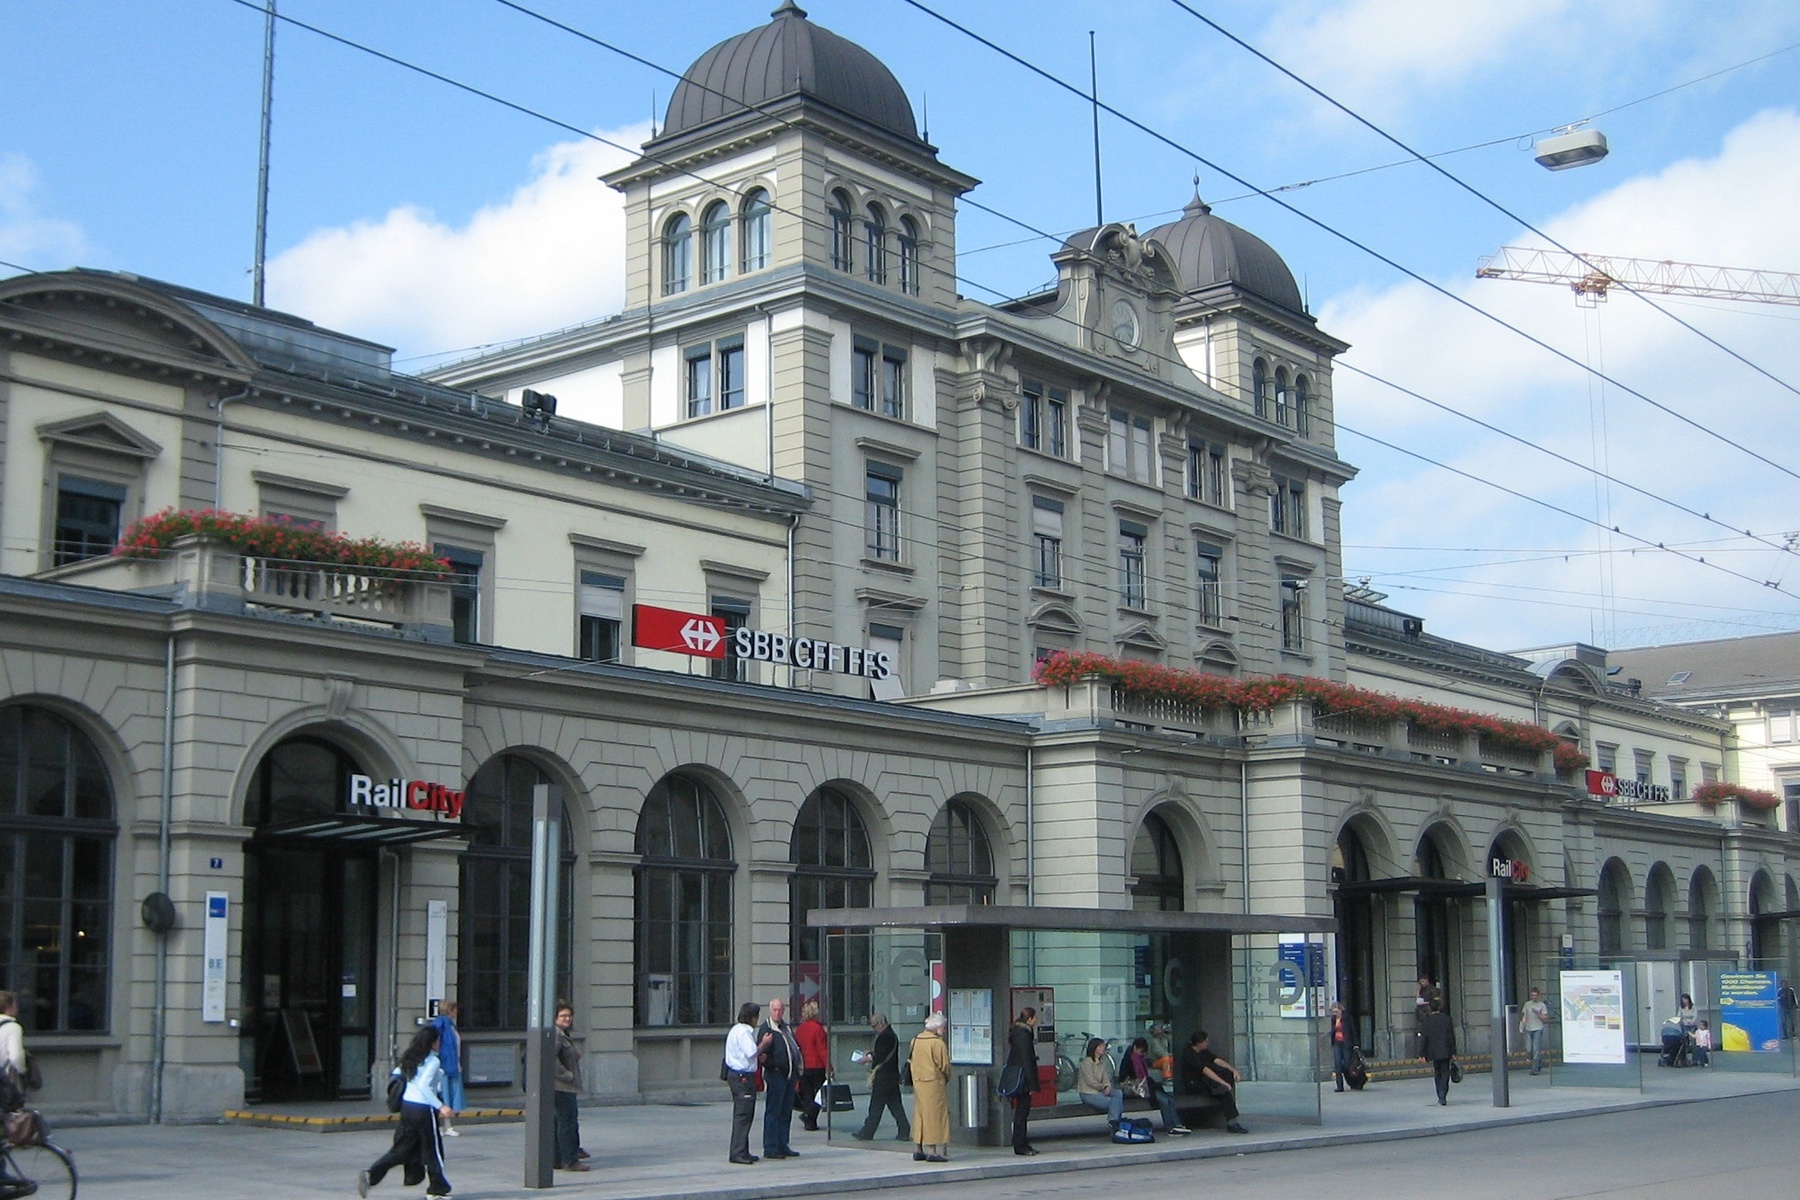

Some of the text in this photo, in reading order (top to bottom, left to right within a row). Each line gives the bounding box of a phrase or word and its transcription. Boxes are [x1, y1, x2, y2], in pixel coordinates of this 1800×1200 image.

[735, 627, 891, 680] SBB CFF FFS
[350, 774, 466, 819] RailCity
[1618, 779, 1670, 802] SBB CFF FFS
